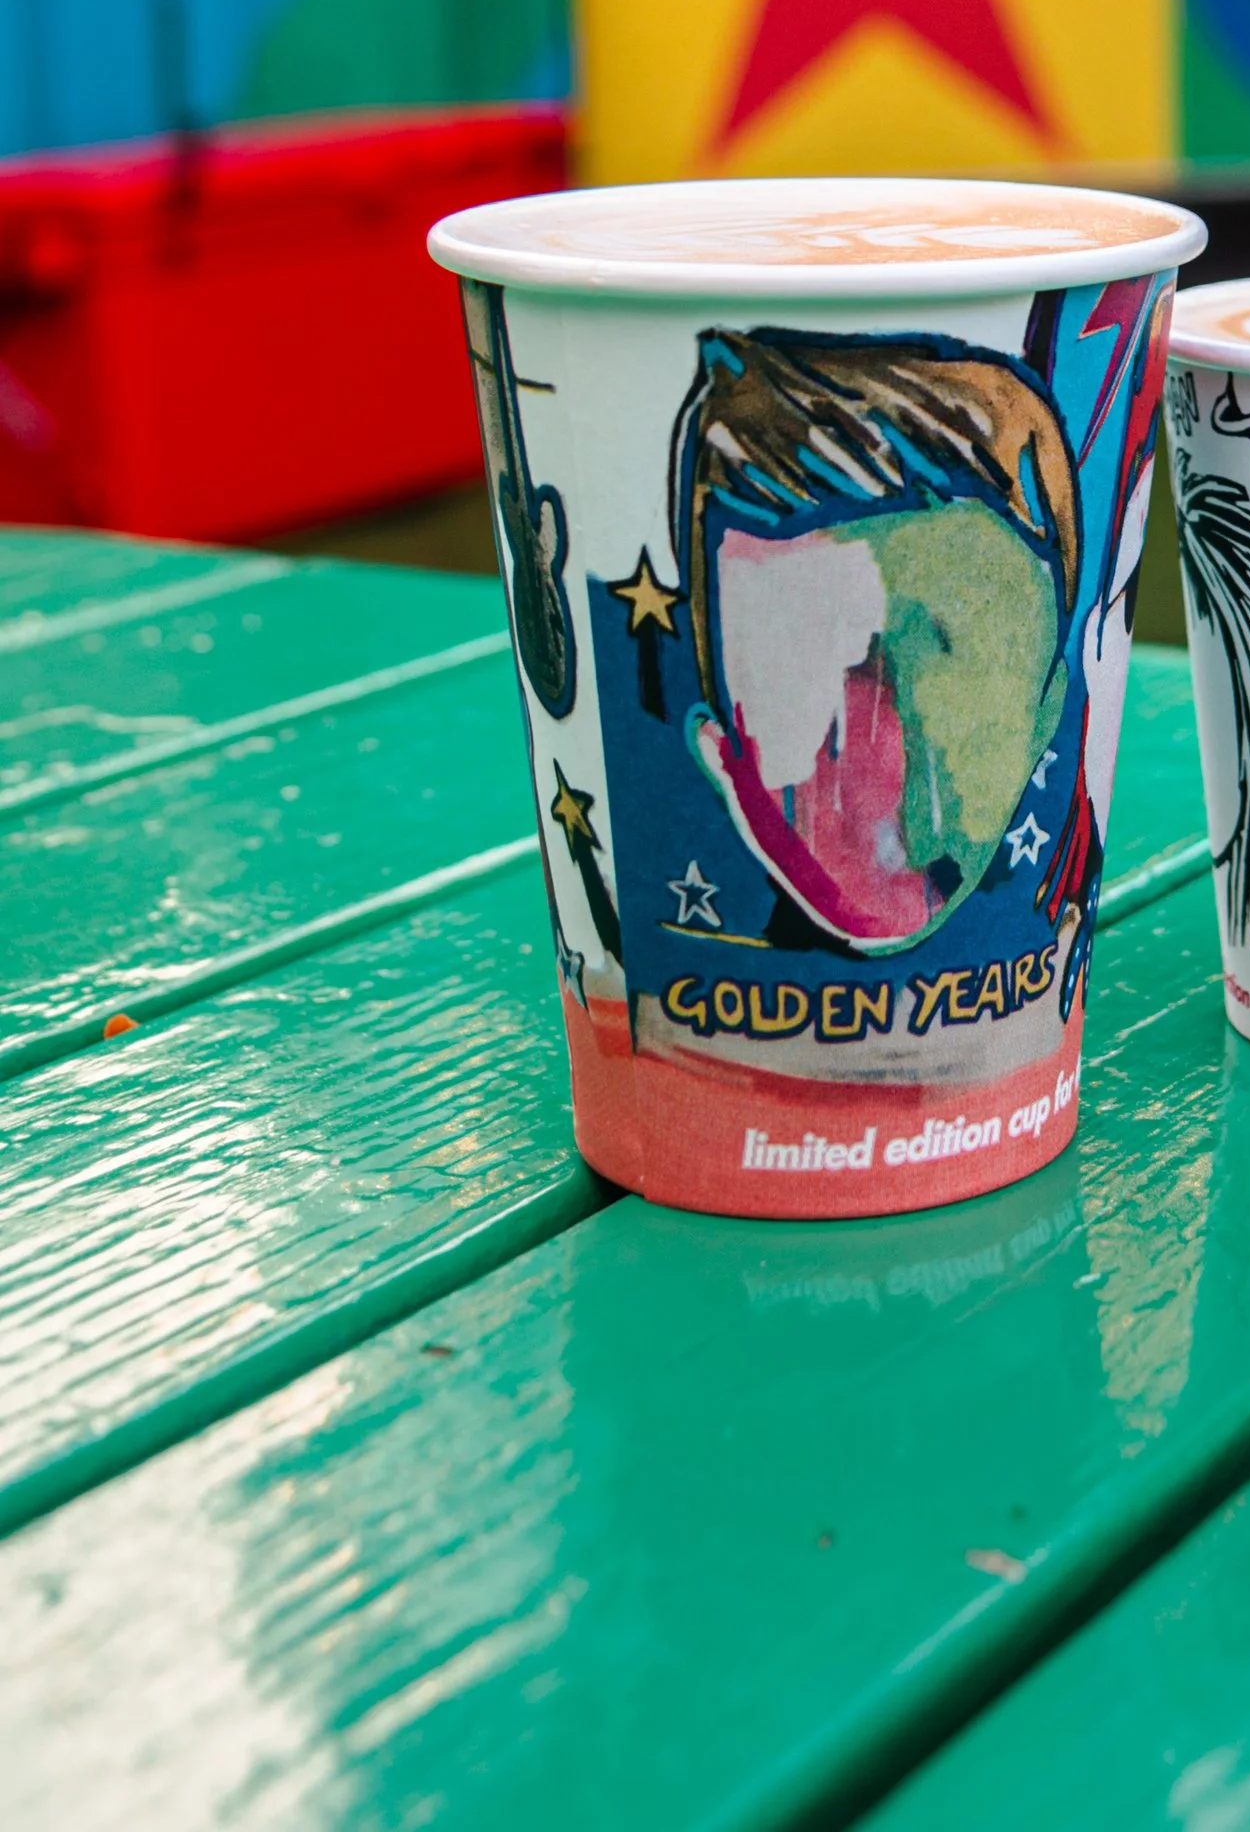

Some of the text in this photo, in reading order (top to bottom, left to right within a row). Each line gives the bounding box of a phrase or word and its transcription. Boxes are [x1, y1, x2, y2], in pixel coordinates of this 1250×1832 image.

[662, 941, 1060, 1043] GOLDEN YEARS
[742, 1127, 878, 1173] limited
[884, 1113, 1001, 1169] edition
[1008, 1097, 1052, 1140] cup
[1053, 1069, 1076, 1116] for
